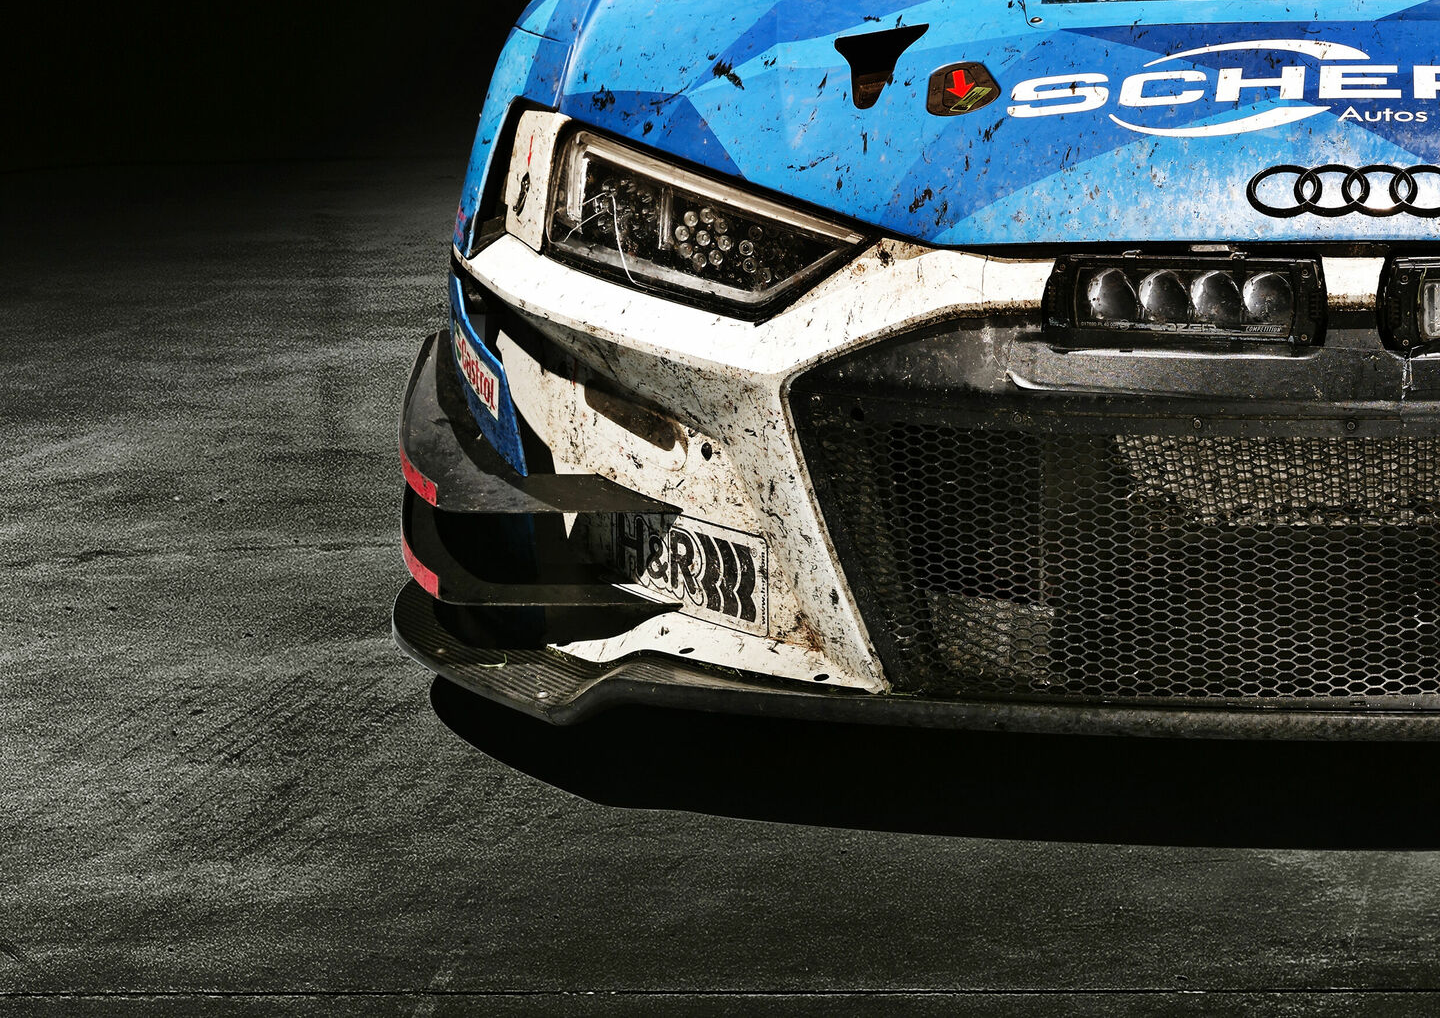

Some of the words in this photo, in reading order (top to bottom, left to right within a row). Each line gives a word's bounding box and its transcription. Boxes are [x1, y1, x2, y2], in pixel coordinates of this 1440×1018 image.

[1337, 105, 1429, 123] Autos
[460, 337, 496, 412] Castrol
[615, 513, 699, 596] H&R
